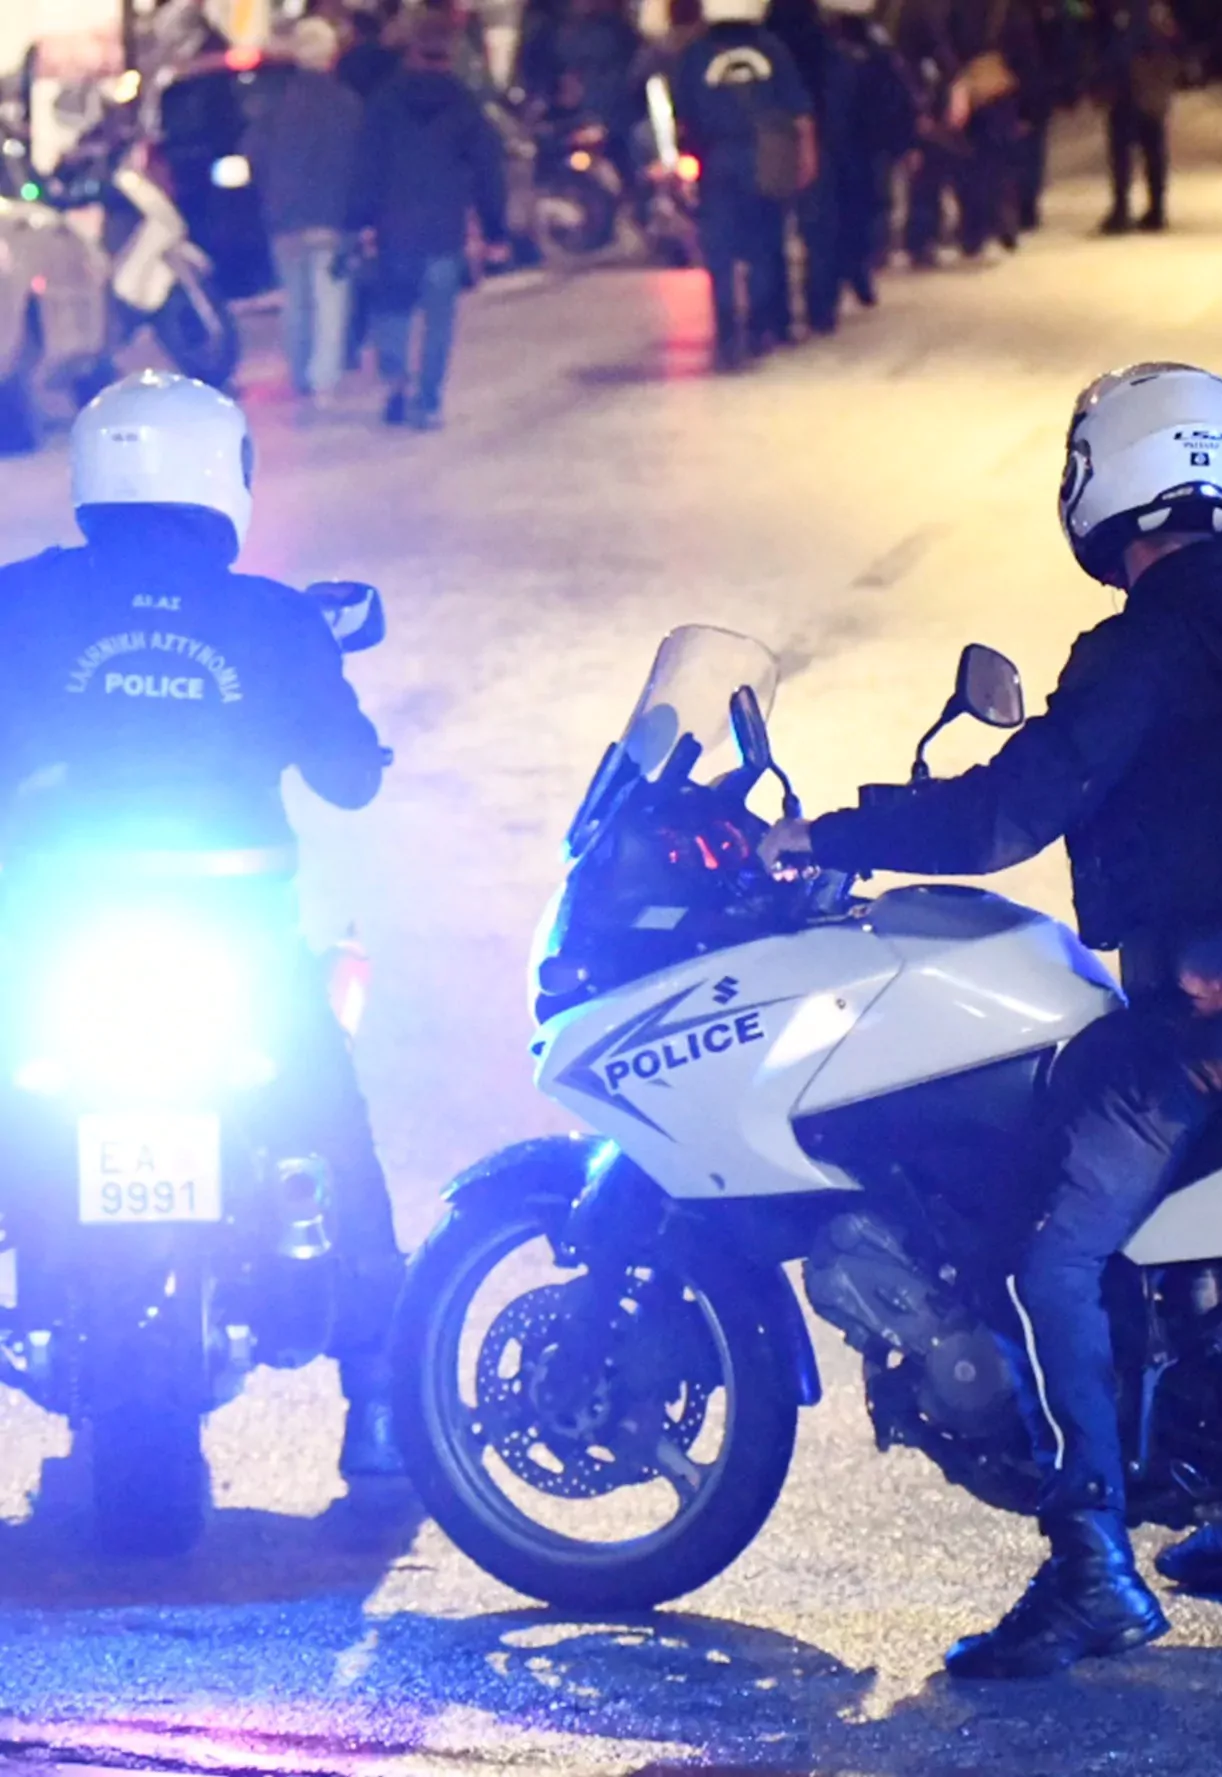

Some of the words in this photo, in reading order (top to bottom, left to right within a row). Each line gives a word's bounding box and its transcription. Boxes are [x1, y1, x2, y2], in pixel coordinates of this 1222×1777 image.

[104, 672, 205, 700] POLICE
[604, 1012, 764, 1090] POLICE
[100, 1141, 156, 1174] EA
[101, 1180, 196, 1215] 9991
